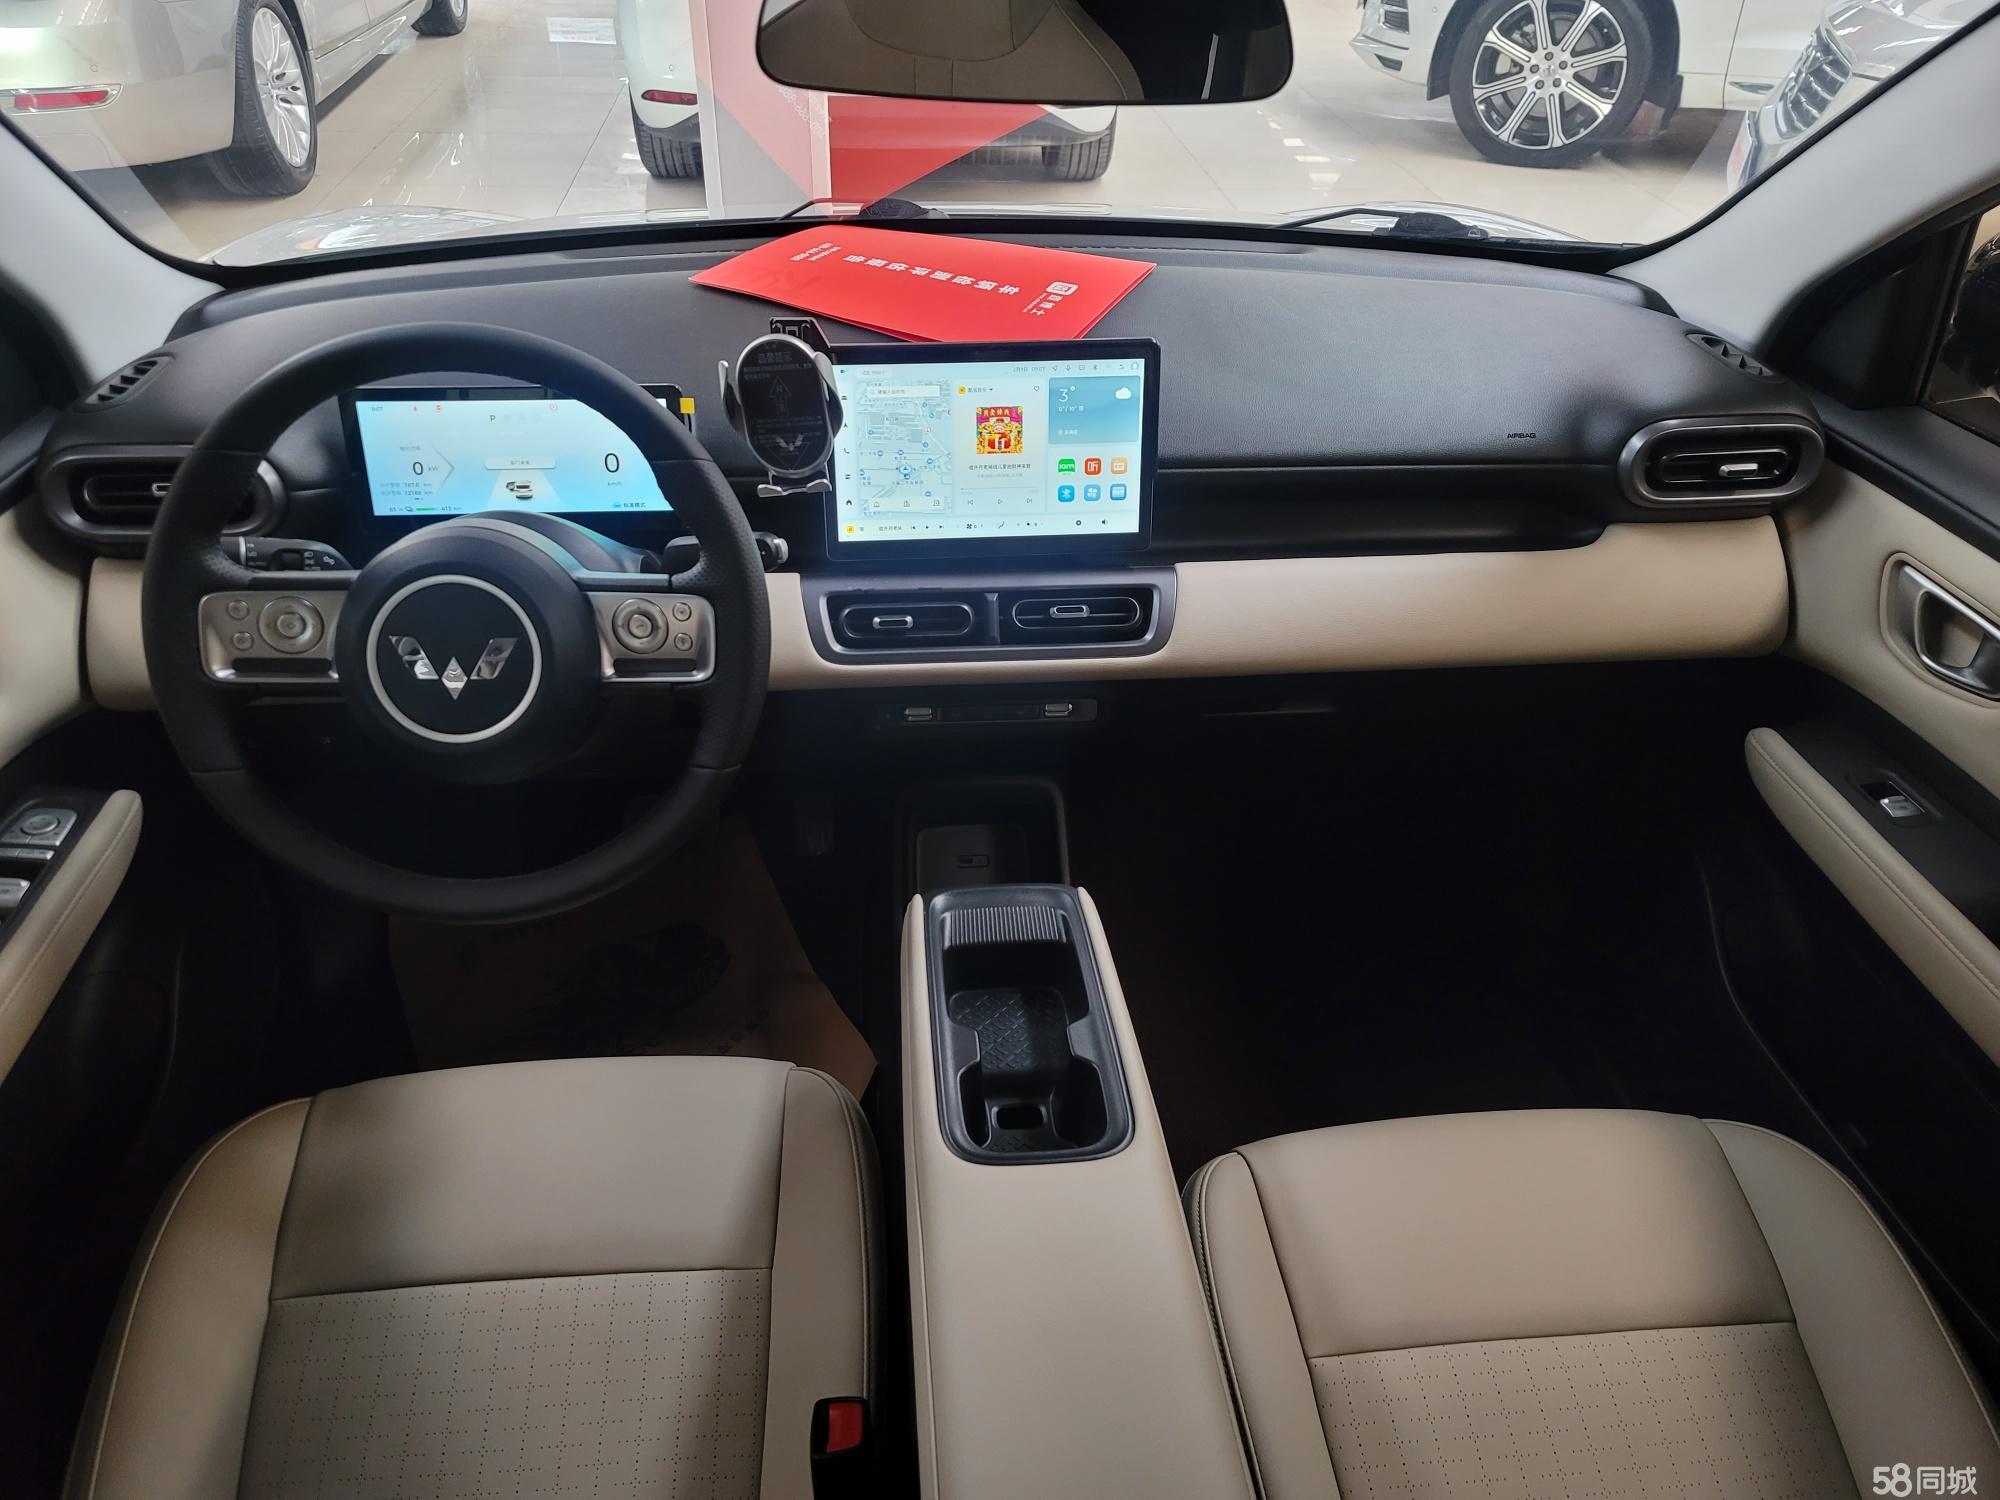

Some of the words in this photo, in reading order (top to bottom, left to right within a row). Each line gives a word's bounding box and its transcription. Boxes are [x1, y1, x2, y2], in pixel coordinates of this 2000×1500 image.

[843, 253, 1020, 296] 车辆检测评估报告
[489, 414, 496, 422] P
[412, 461, 424, 476] 0
[604, 452, 620, 473] 0
[1087, 461, 1099, 472] 听
